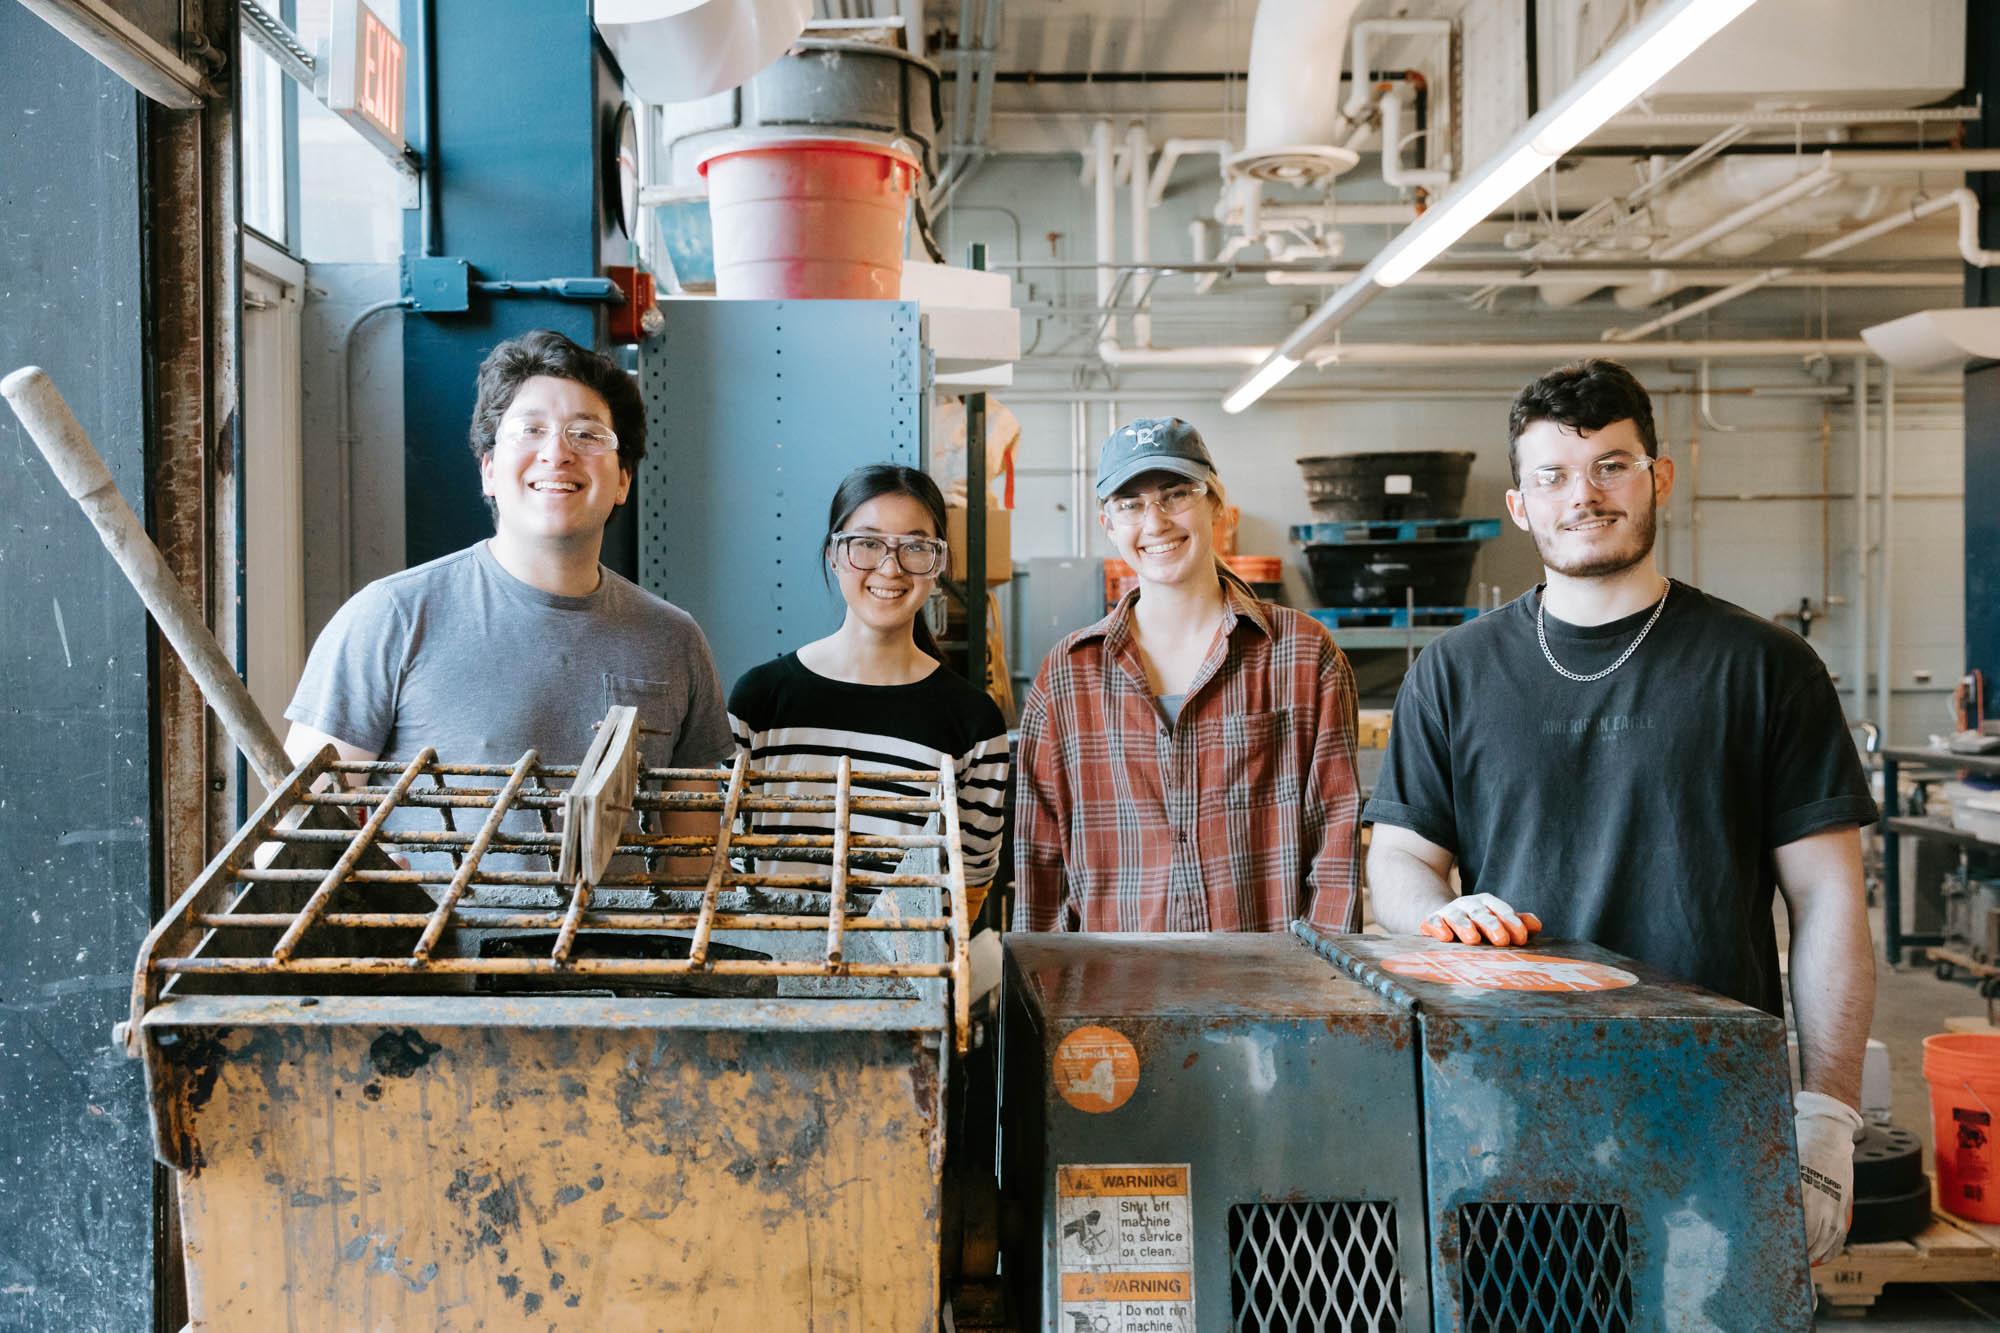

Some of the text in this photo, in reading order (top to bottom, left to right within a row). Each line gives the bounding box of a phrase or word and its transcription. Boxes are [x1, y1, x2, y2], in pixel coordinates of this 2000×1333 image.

[362, 11, 402, 135] EXIT
[1542, 717, 1609, 735] AMERICN
[1102, 1175, 1178, 1188] WARNING
[1800, 1165, 1823, 1181] FIRM
[1824, 1176, 1842, 1190] GRIP
[1120, 1201, 1170, 1213] Shut off
[1121, 1216, 1171, 1227] machine
[1122, 1230, 1183, 1242] to service
[1122, 1247, 1175, 1257] or clean.
[1126, 1305, 1142, 1316] Do
[1145, 1305, 1165, 1316] not
[1126, 1321, 1173, 1332] machine
